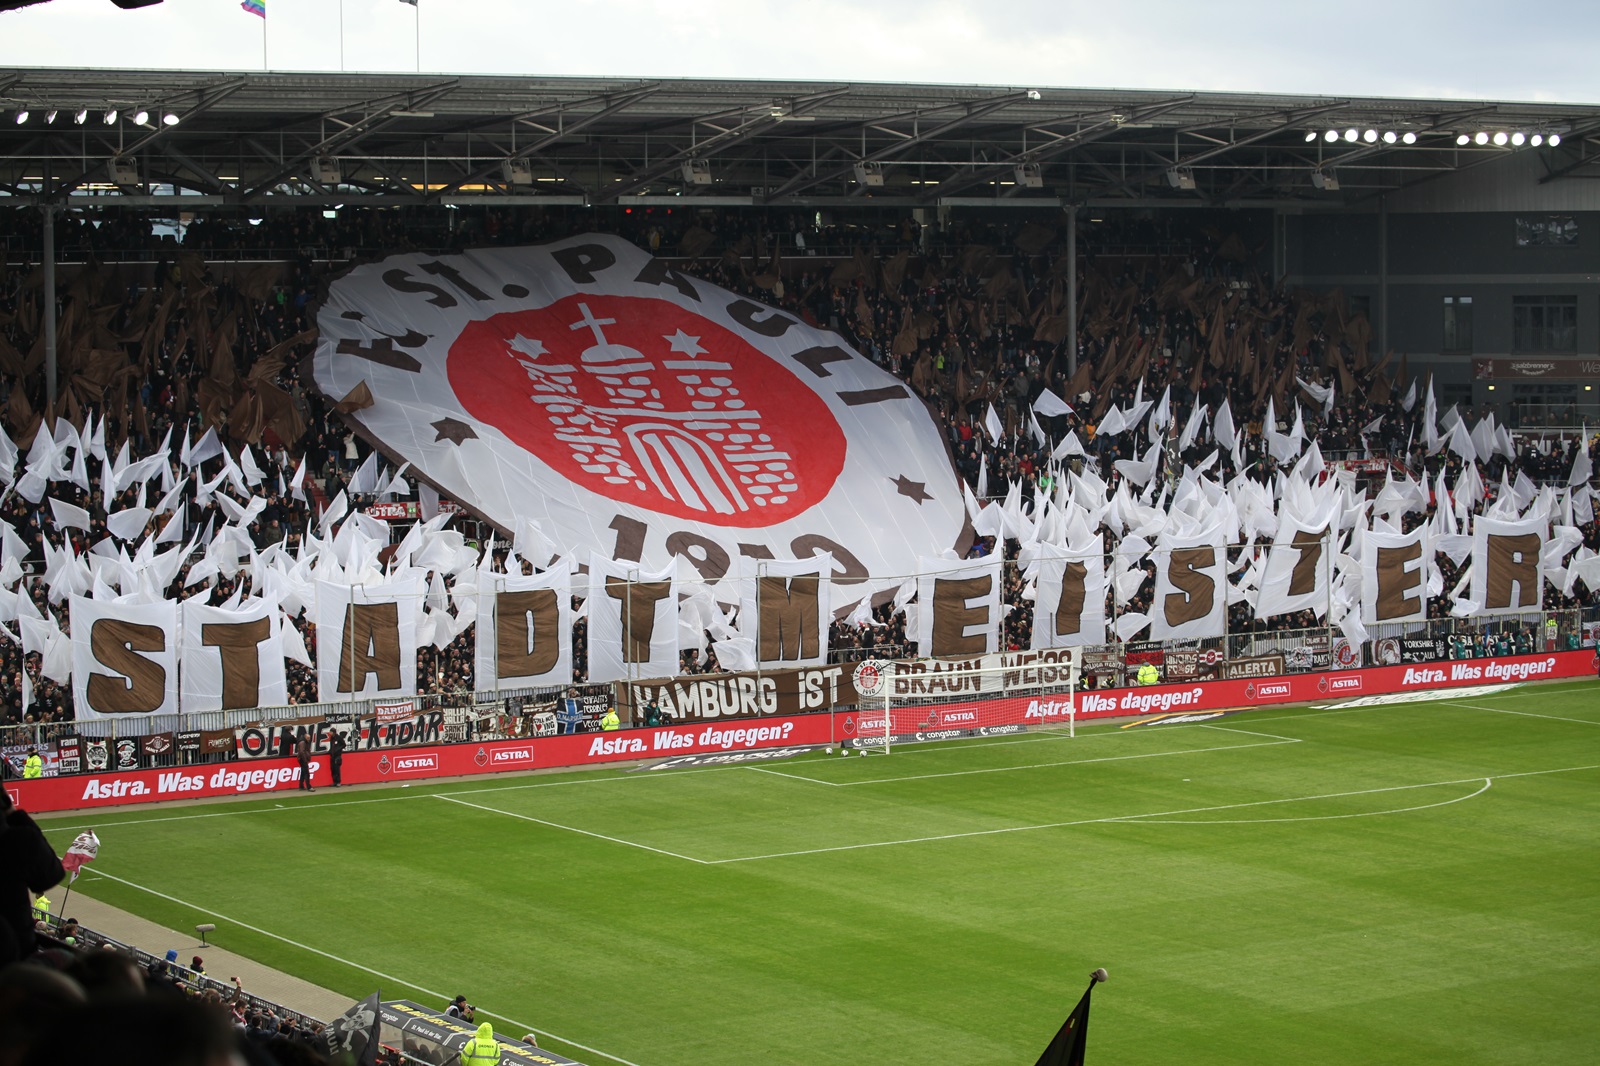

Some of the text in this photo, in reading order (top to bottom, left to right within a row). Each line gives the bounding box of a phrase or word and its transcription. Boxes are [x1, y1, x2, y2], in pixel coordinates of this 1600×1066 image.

[336, 244, 911, 406] FC ST. PAULI
[1404, 641, 1434, 649] YORKSHIRE
[1229, 662, 1276, 676] ALERTA
[1403, 658, 1556, 685] Astra. Was dagegen?
[894, 659, 981, 694] BRAUN
[1332, 679, 1359, 688] ASTRA
[1260, 686, 1288, 696] ASTRA
[633, 677, 778, 719] HAMBURG
[1025, 688, 1203, 719] Astra. Was dagegen?
[377, 705, 412, 715] DARUM
[944, 712, 975, 722] ASTRA
[366, 711, 443, 750] KADAR
[989, 725, 1019, 734] congstar
[589, 722, 794, 756] Astra. Was dagegen?
[926, 730, 961, 740] congstar
[61, 738, 78, 747] ram
[863, 736, 899, 746] congsar
[61, 749, 79, 758] tam
[494, 750, 530, 761] ASTRA
[61, 760, 78, 768] tam
[397, 758, 434, 768] ASTRA
[82, 762, 320, 800] Astra. Was dagegen?
